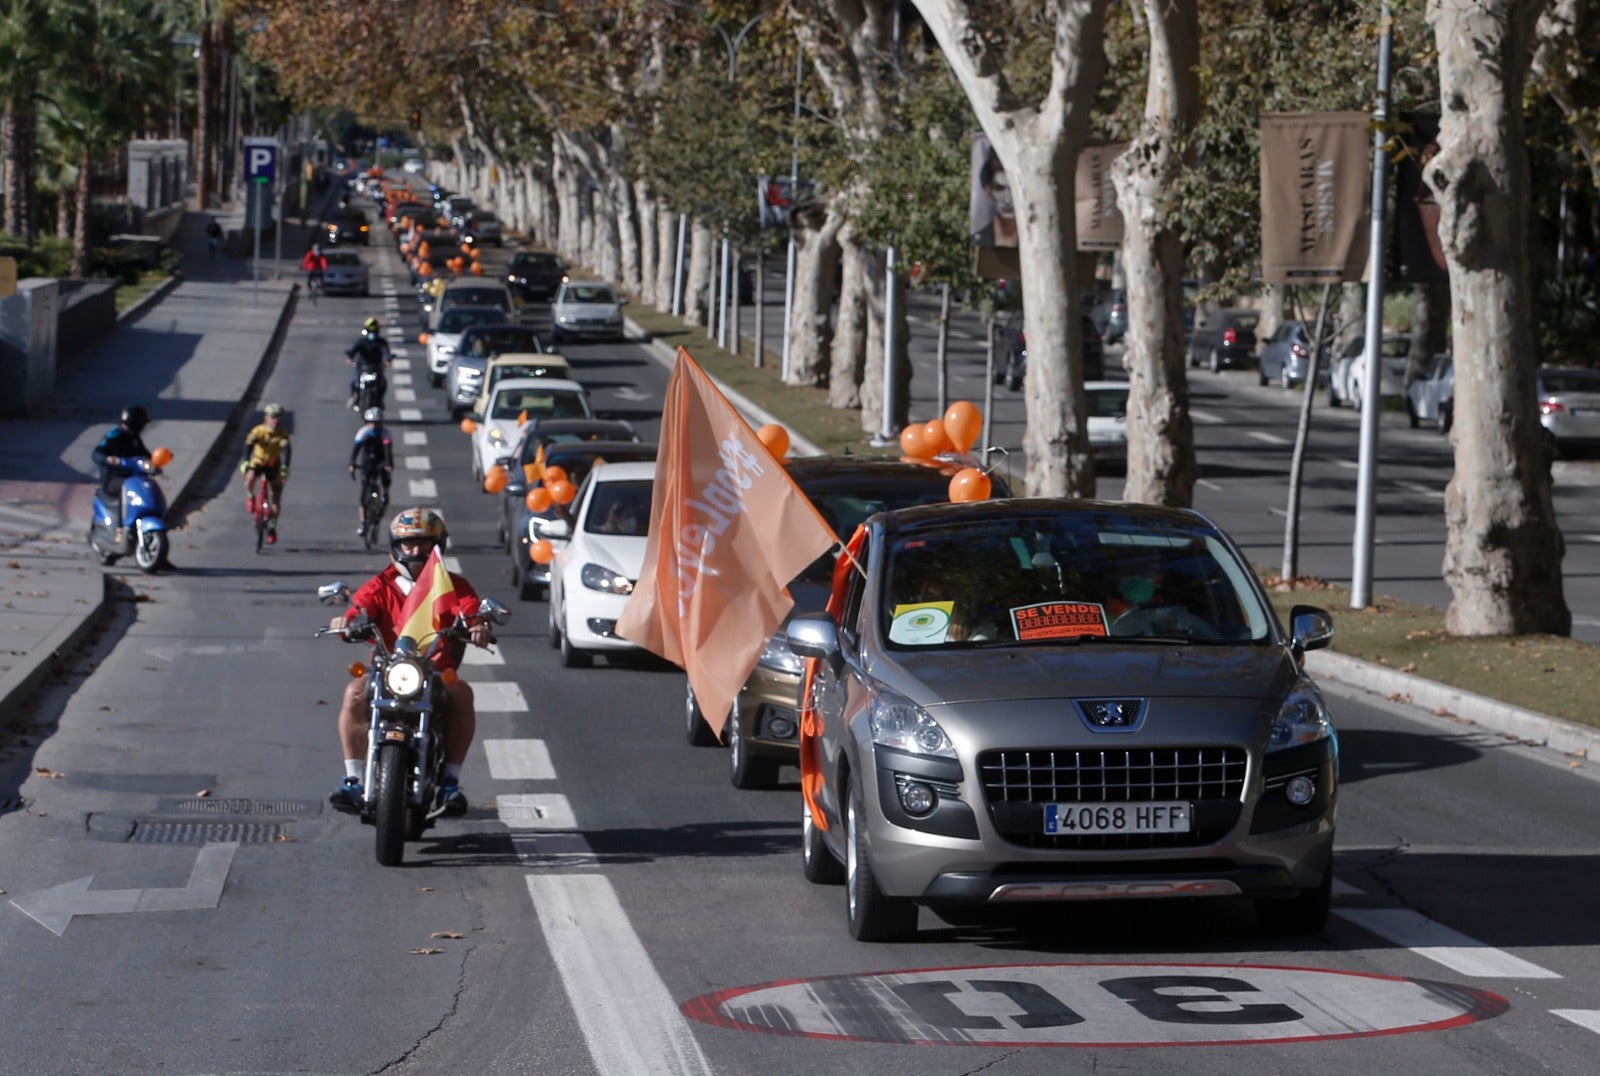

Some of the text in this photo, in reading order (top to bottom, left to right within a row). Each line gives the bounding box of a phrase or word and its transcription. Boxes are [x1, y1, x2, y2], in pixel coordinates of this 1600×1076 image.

[250, 148, 272, 175] P
[1016, 604, 1100, 619] SE VENDE
[1062, 806, 1126, 830] 4068
[1136, 806, 1184, 829] HFF
